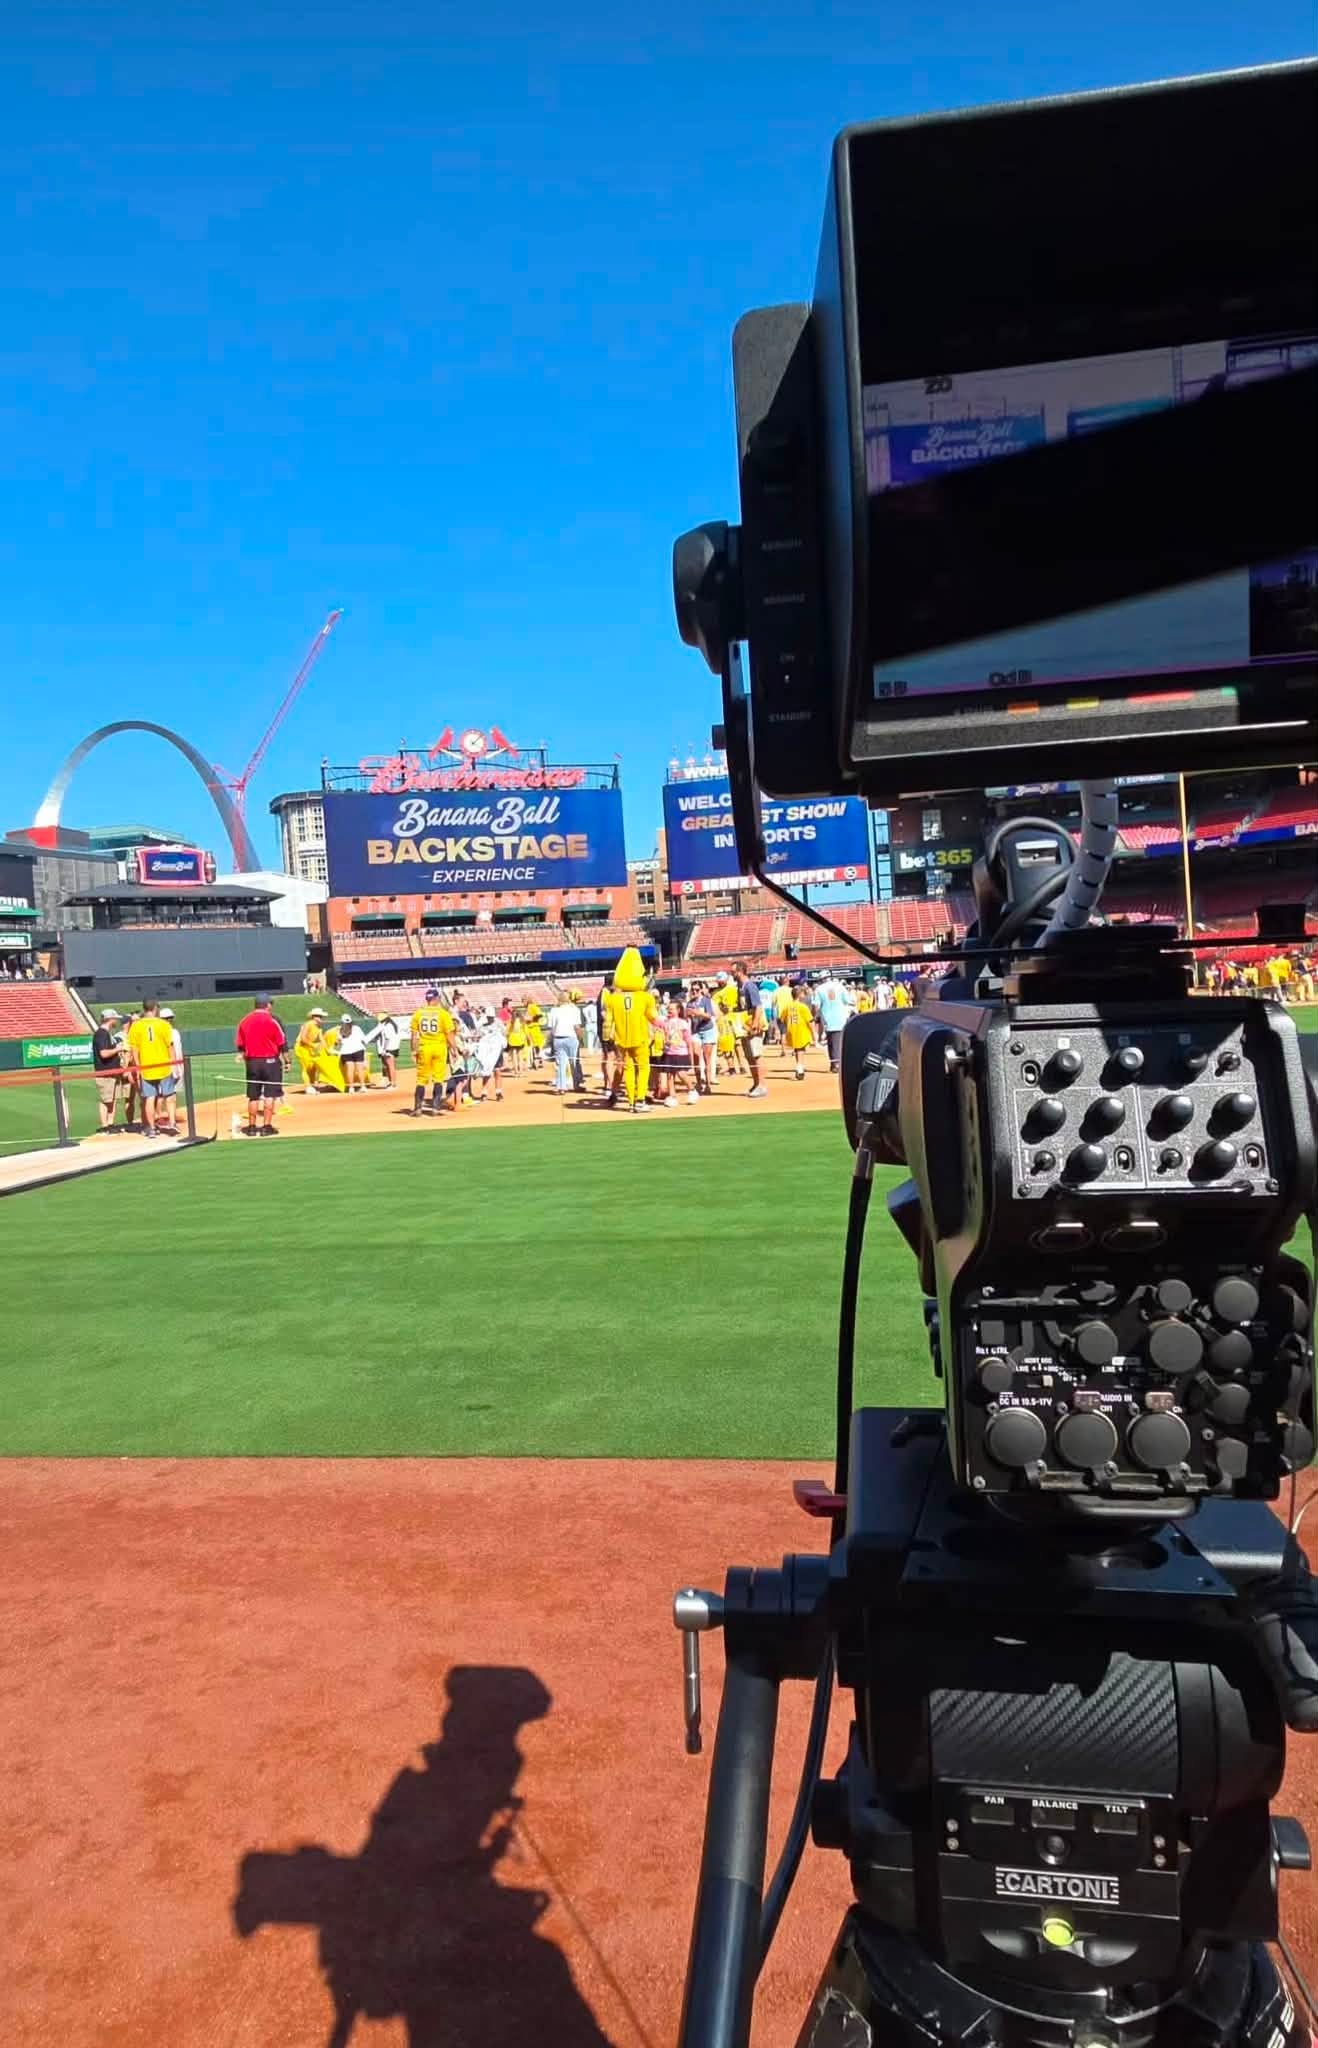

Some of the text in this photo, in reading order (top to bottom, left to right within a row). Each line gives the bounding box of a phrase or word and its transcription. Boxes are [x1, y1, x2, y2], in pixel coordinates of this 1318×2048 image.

[678, 793, 732, 811] WELC
[393, 796, 560, 837] Banana Ball
[786, 802, 847, 822] SHOW
[367, 834, 588, 864] BACKSTAGE
[714, 833, 734, 848] IN
[900, 848, 973, 869] bet365
[432, 867, 535, 884] EXPERIENCE
[465, 952, 542, 965] BACKSTAGE
[421, 1018, 438, 1033] 66
[42, 1041, 92, 1056] National
[984, 1796, 1129, 1814] PAN BALANCE TILT
[1004, 1872, 1109, 1900] CARTONI
